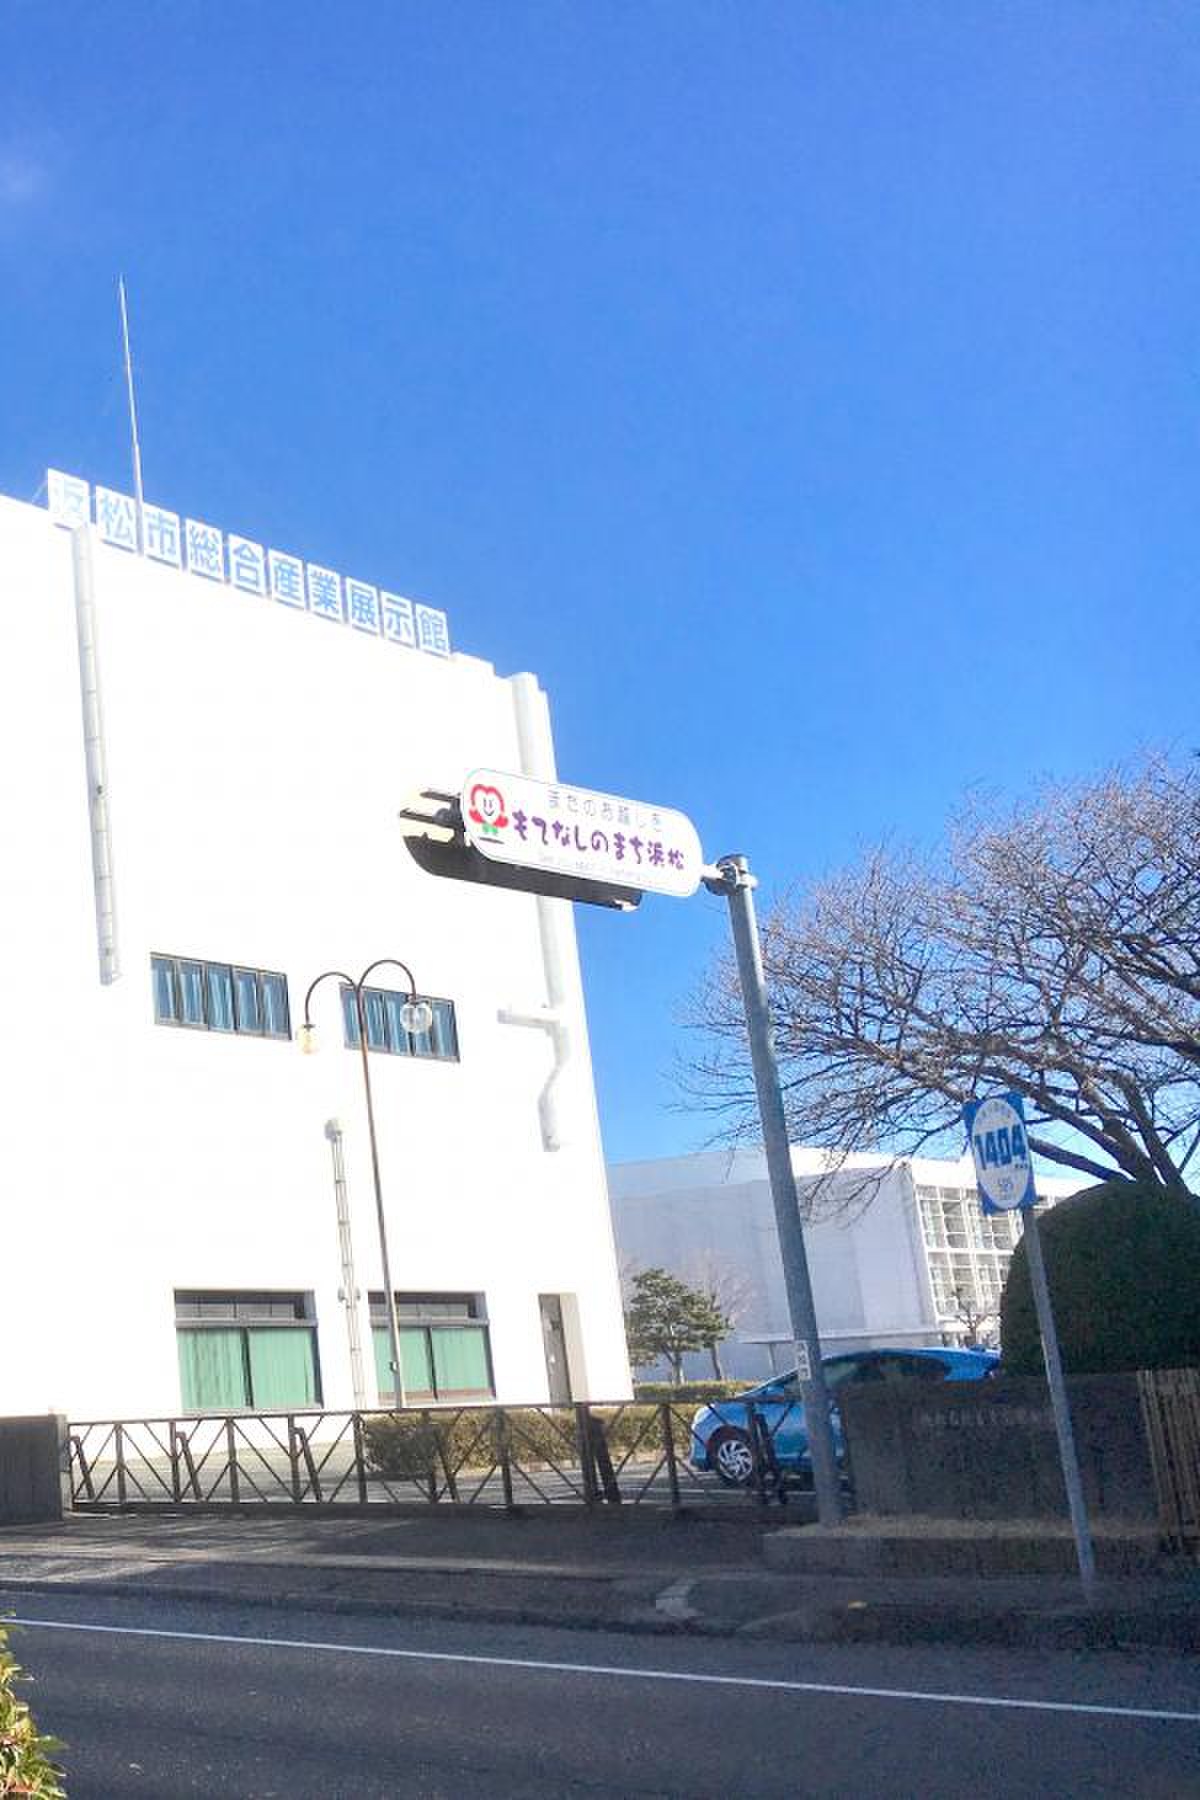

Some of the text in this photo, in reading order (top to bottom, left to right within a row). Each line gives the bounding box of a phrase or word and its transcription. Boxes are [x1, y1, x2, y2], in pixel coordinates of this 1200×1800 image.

[512, 809, 684, 870] もてなしのまち浜松
